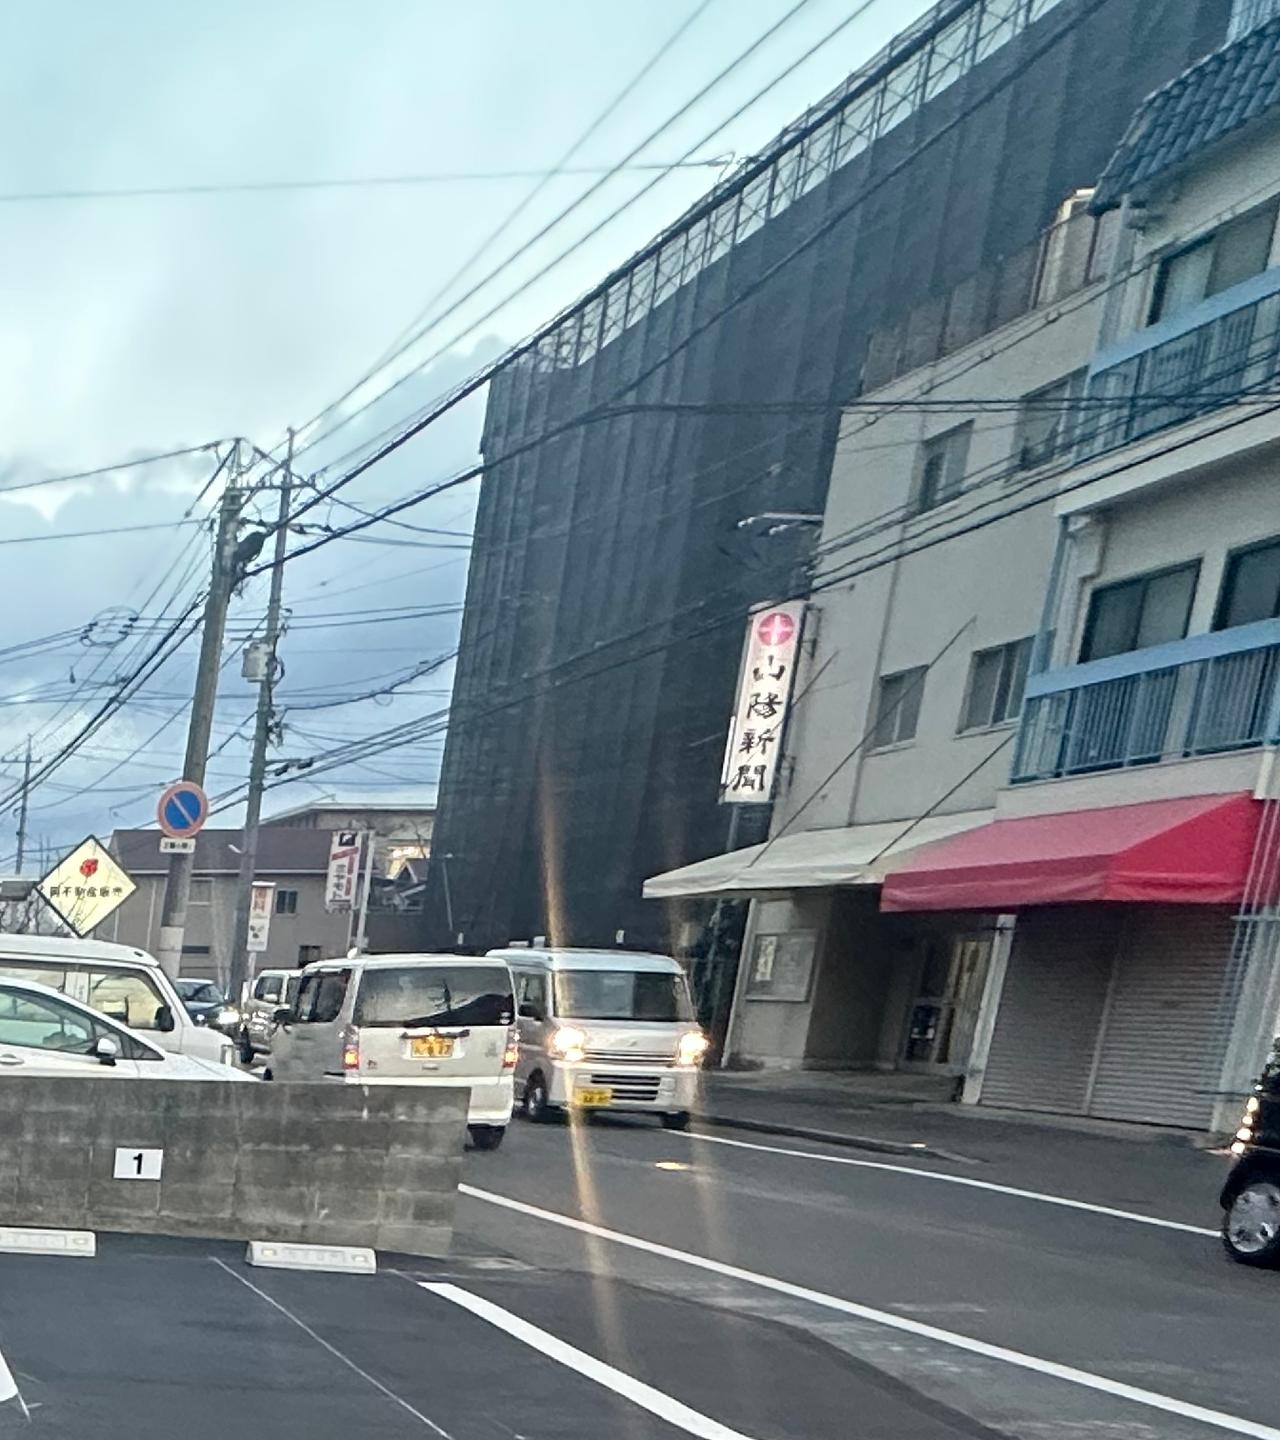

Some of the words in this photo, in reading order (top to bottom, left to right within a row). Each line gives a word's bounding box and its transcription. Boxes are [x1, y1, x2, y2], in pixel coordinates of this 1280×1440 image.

[732, 655, 785, 791] 山陽新聞
[133, 1152, 143, 1175] 1
